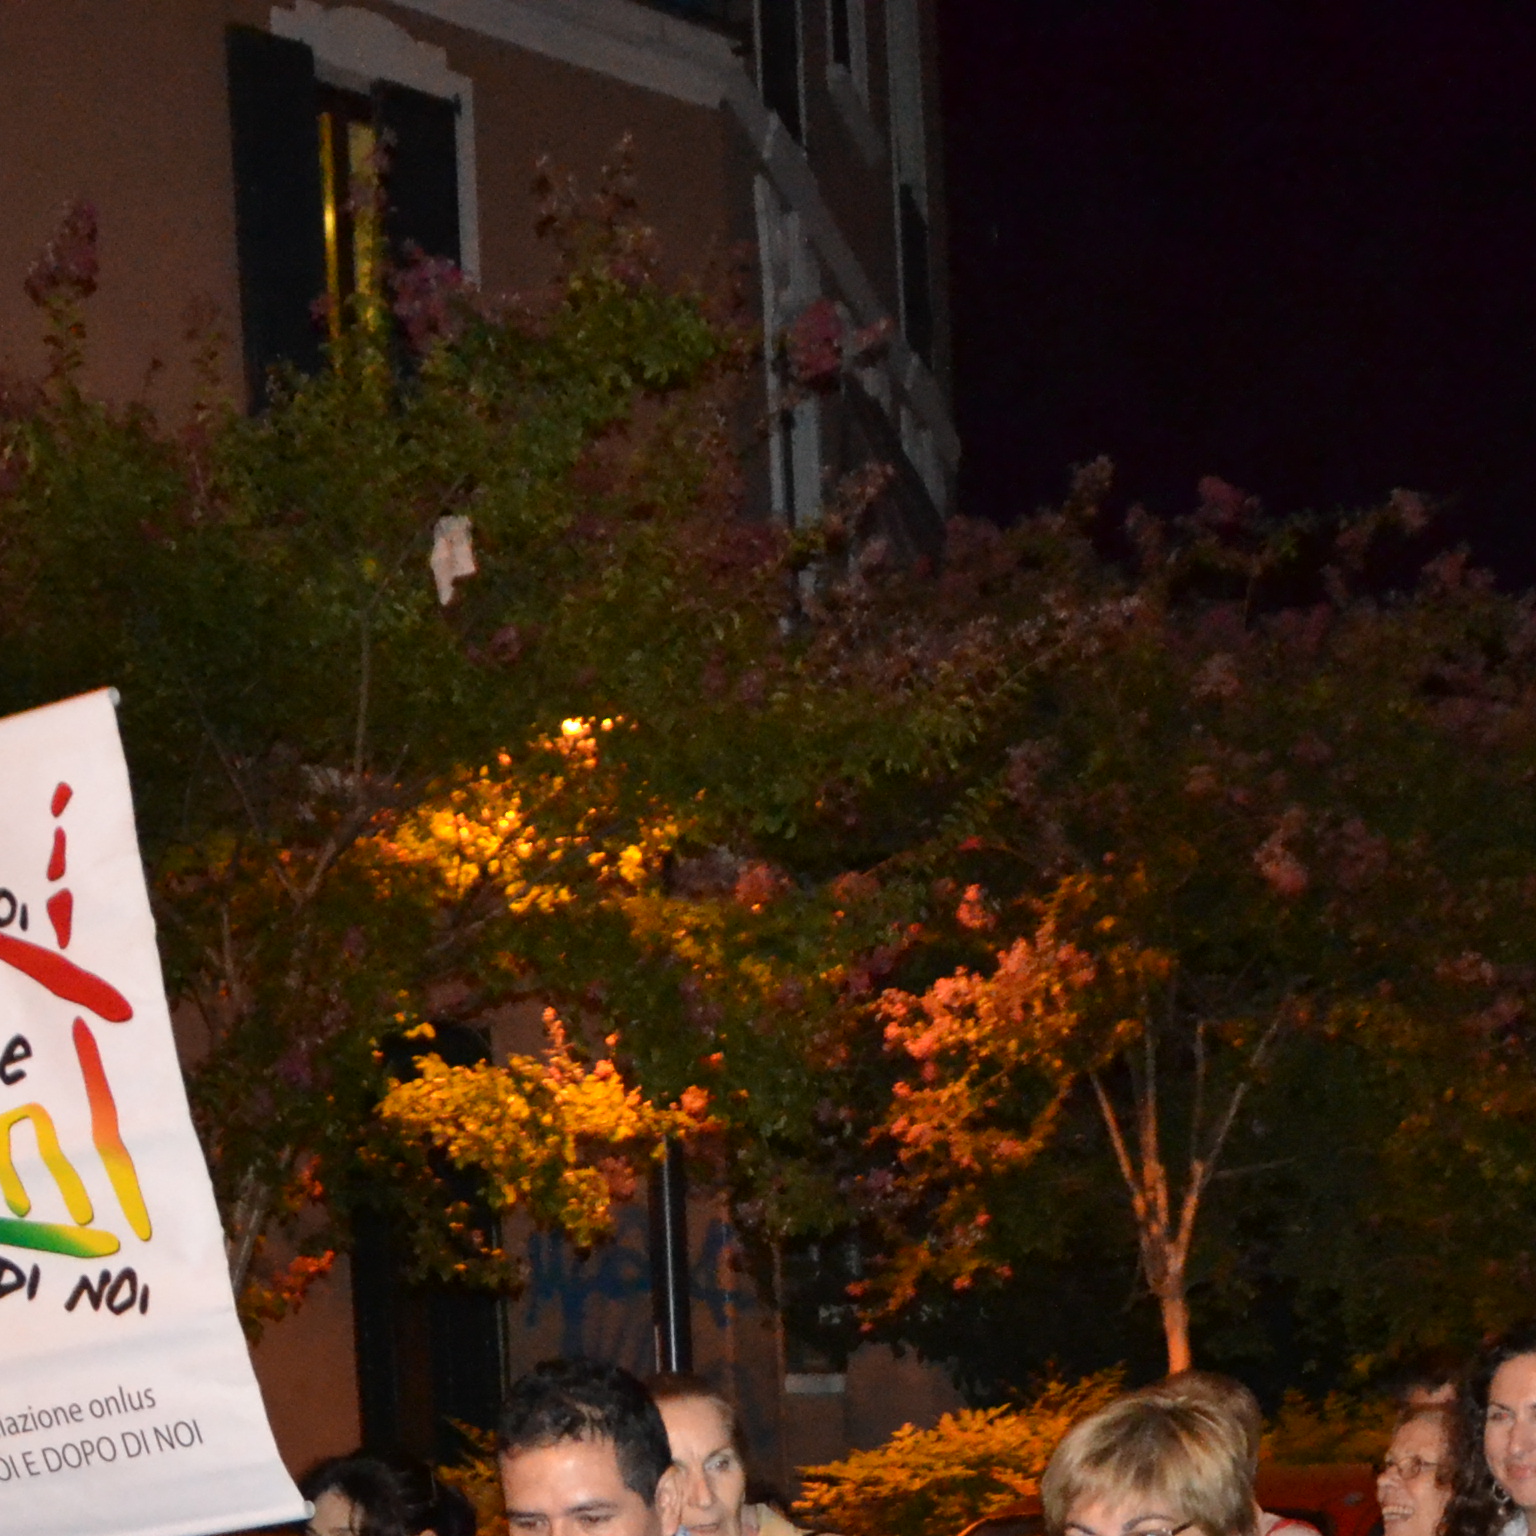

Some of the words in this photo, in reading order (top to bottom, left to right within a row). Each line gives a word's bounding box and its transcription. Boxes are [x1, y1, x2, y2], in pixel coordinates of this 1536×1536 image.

[89, 1384, 158, 1418] onlus
[24, 1450, 42, 1477] E
[42, 1435, 118, 1474] DOPO
[121, 1429, 150, 1458] DI
[154, 1418, 204, 1452] NOI
